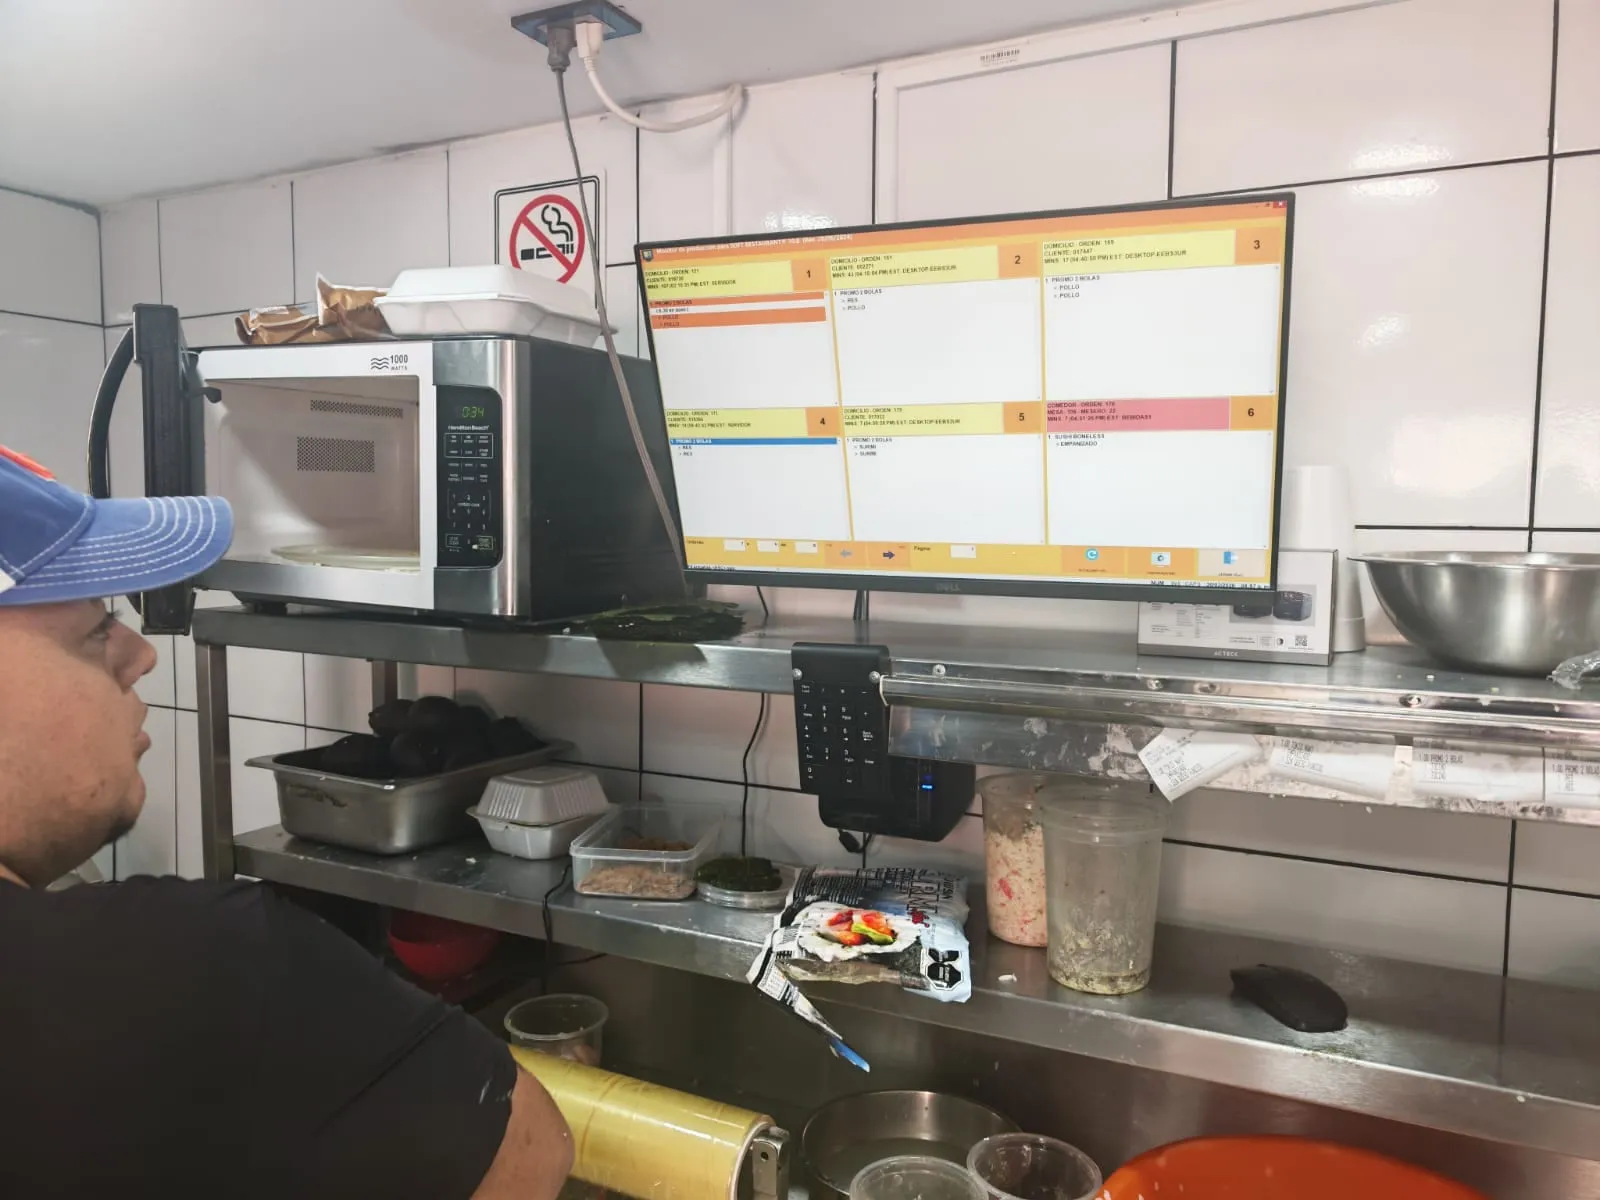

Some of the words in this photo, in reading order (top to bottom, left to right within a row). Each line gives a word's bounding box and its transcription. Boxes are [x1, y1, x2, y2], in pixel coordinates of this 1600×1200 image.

[1044, 242, 1075, 250] DOMICILIO
[1254, 240, 1260, 250] 3
[1014, 256, 1021, 264] 2
[390, 354, 408, 364] 1000
[1019, 412, 1025, 421] 5
[1248, 408, 1254, 417] 6
